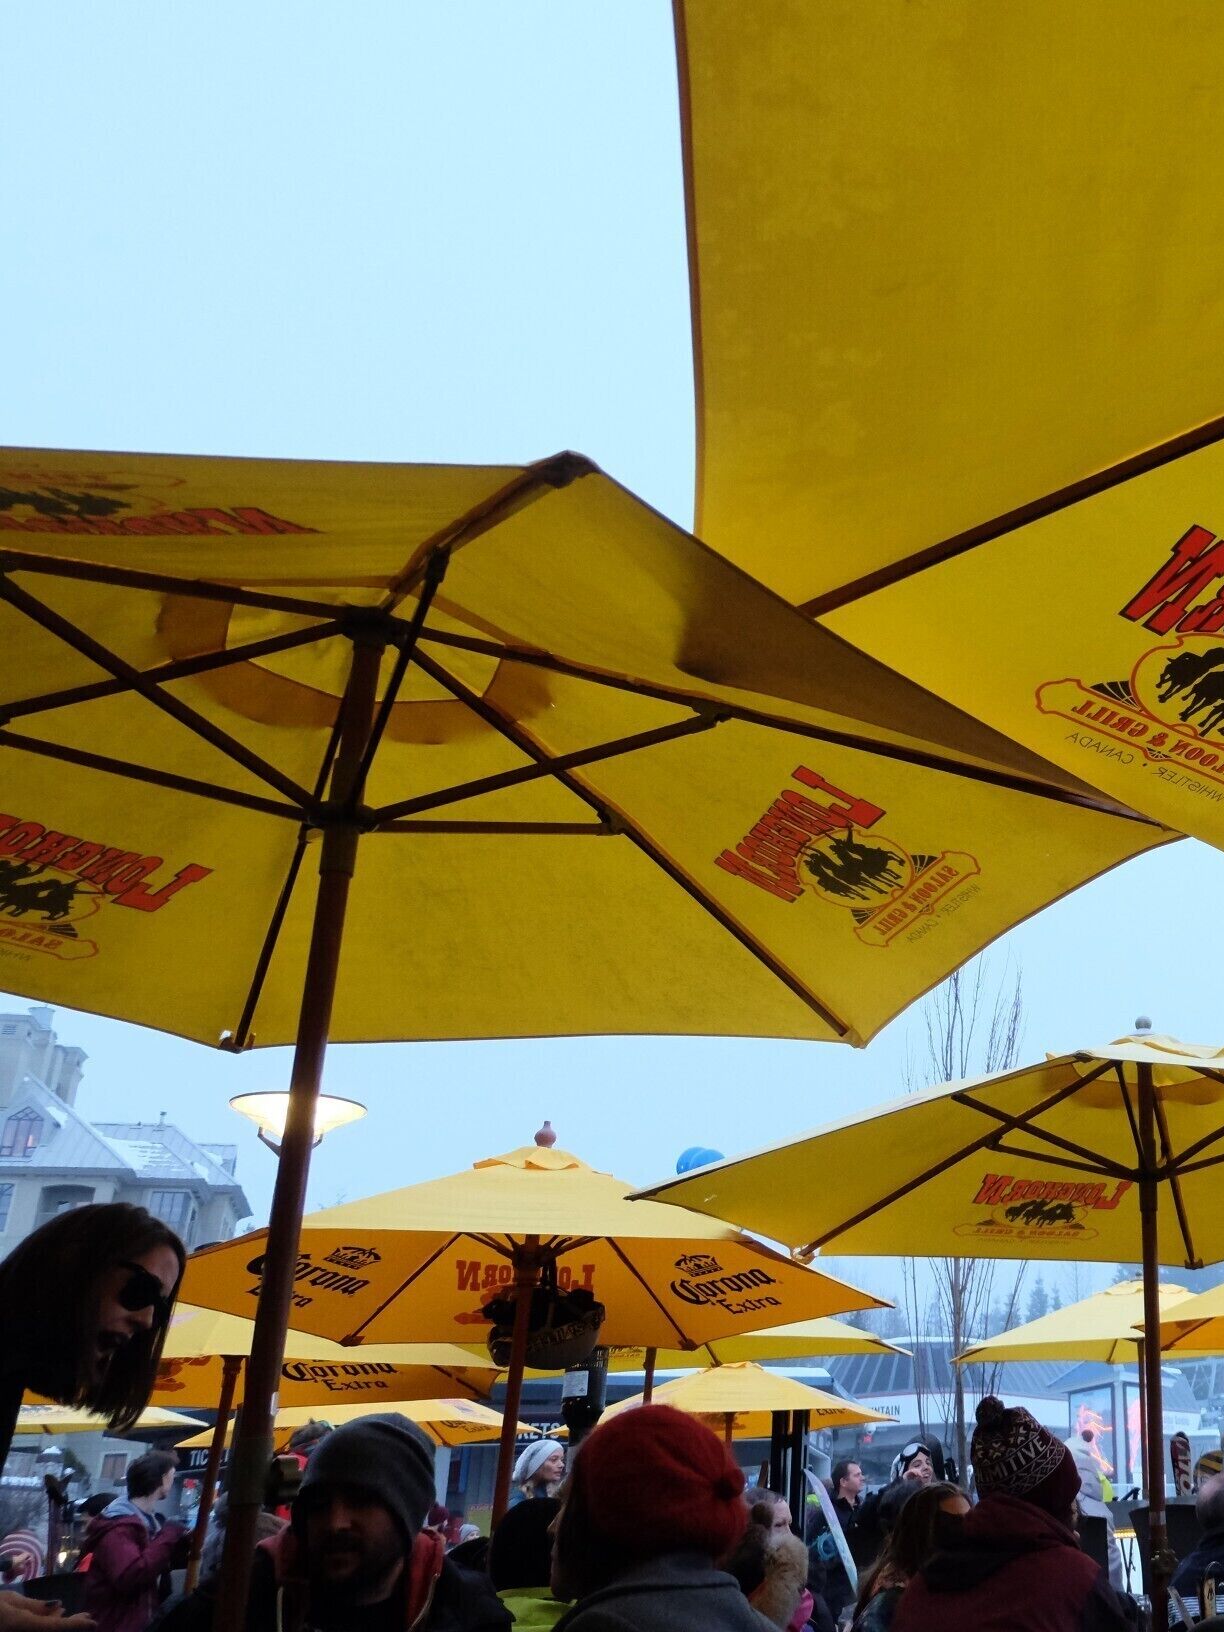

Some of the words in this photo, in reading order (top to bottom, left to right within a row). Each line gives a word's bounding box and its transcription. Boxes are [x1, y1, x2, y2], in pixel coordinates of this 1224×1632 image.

[670, 1268, 777, 1306] Corona
[716, 1296, 782, 1315] Extra
[281, 1362, 398, 1383] Corona
[321, 1378, 389, 1392] Extra
